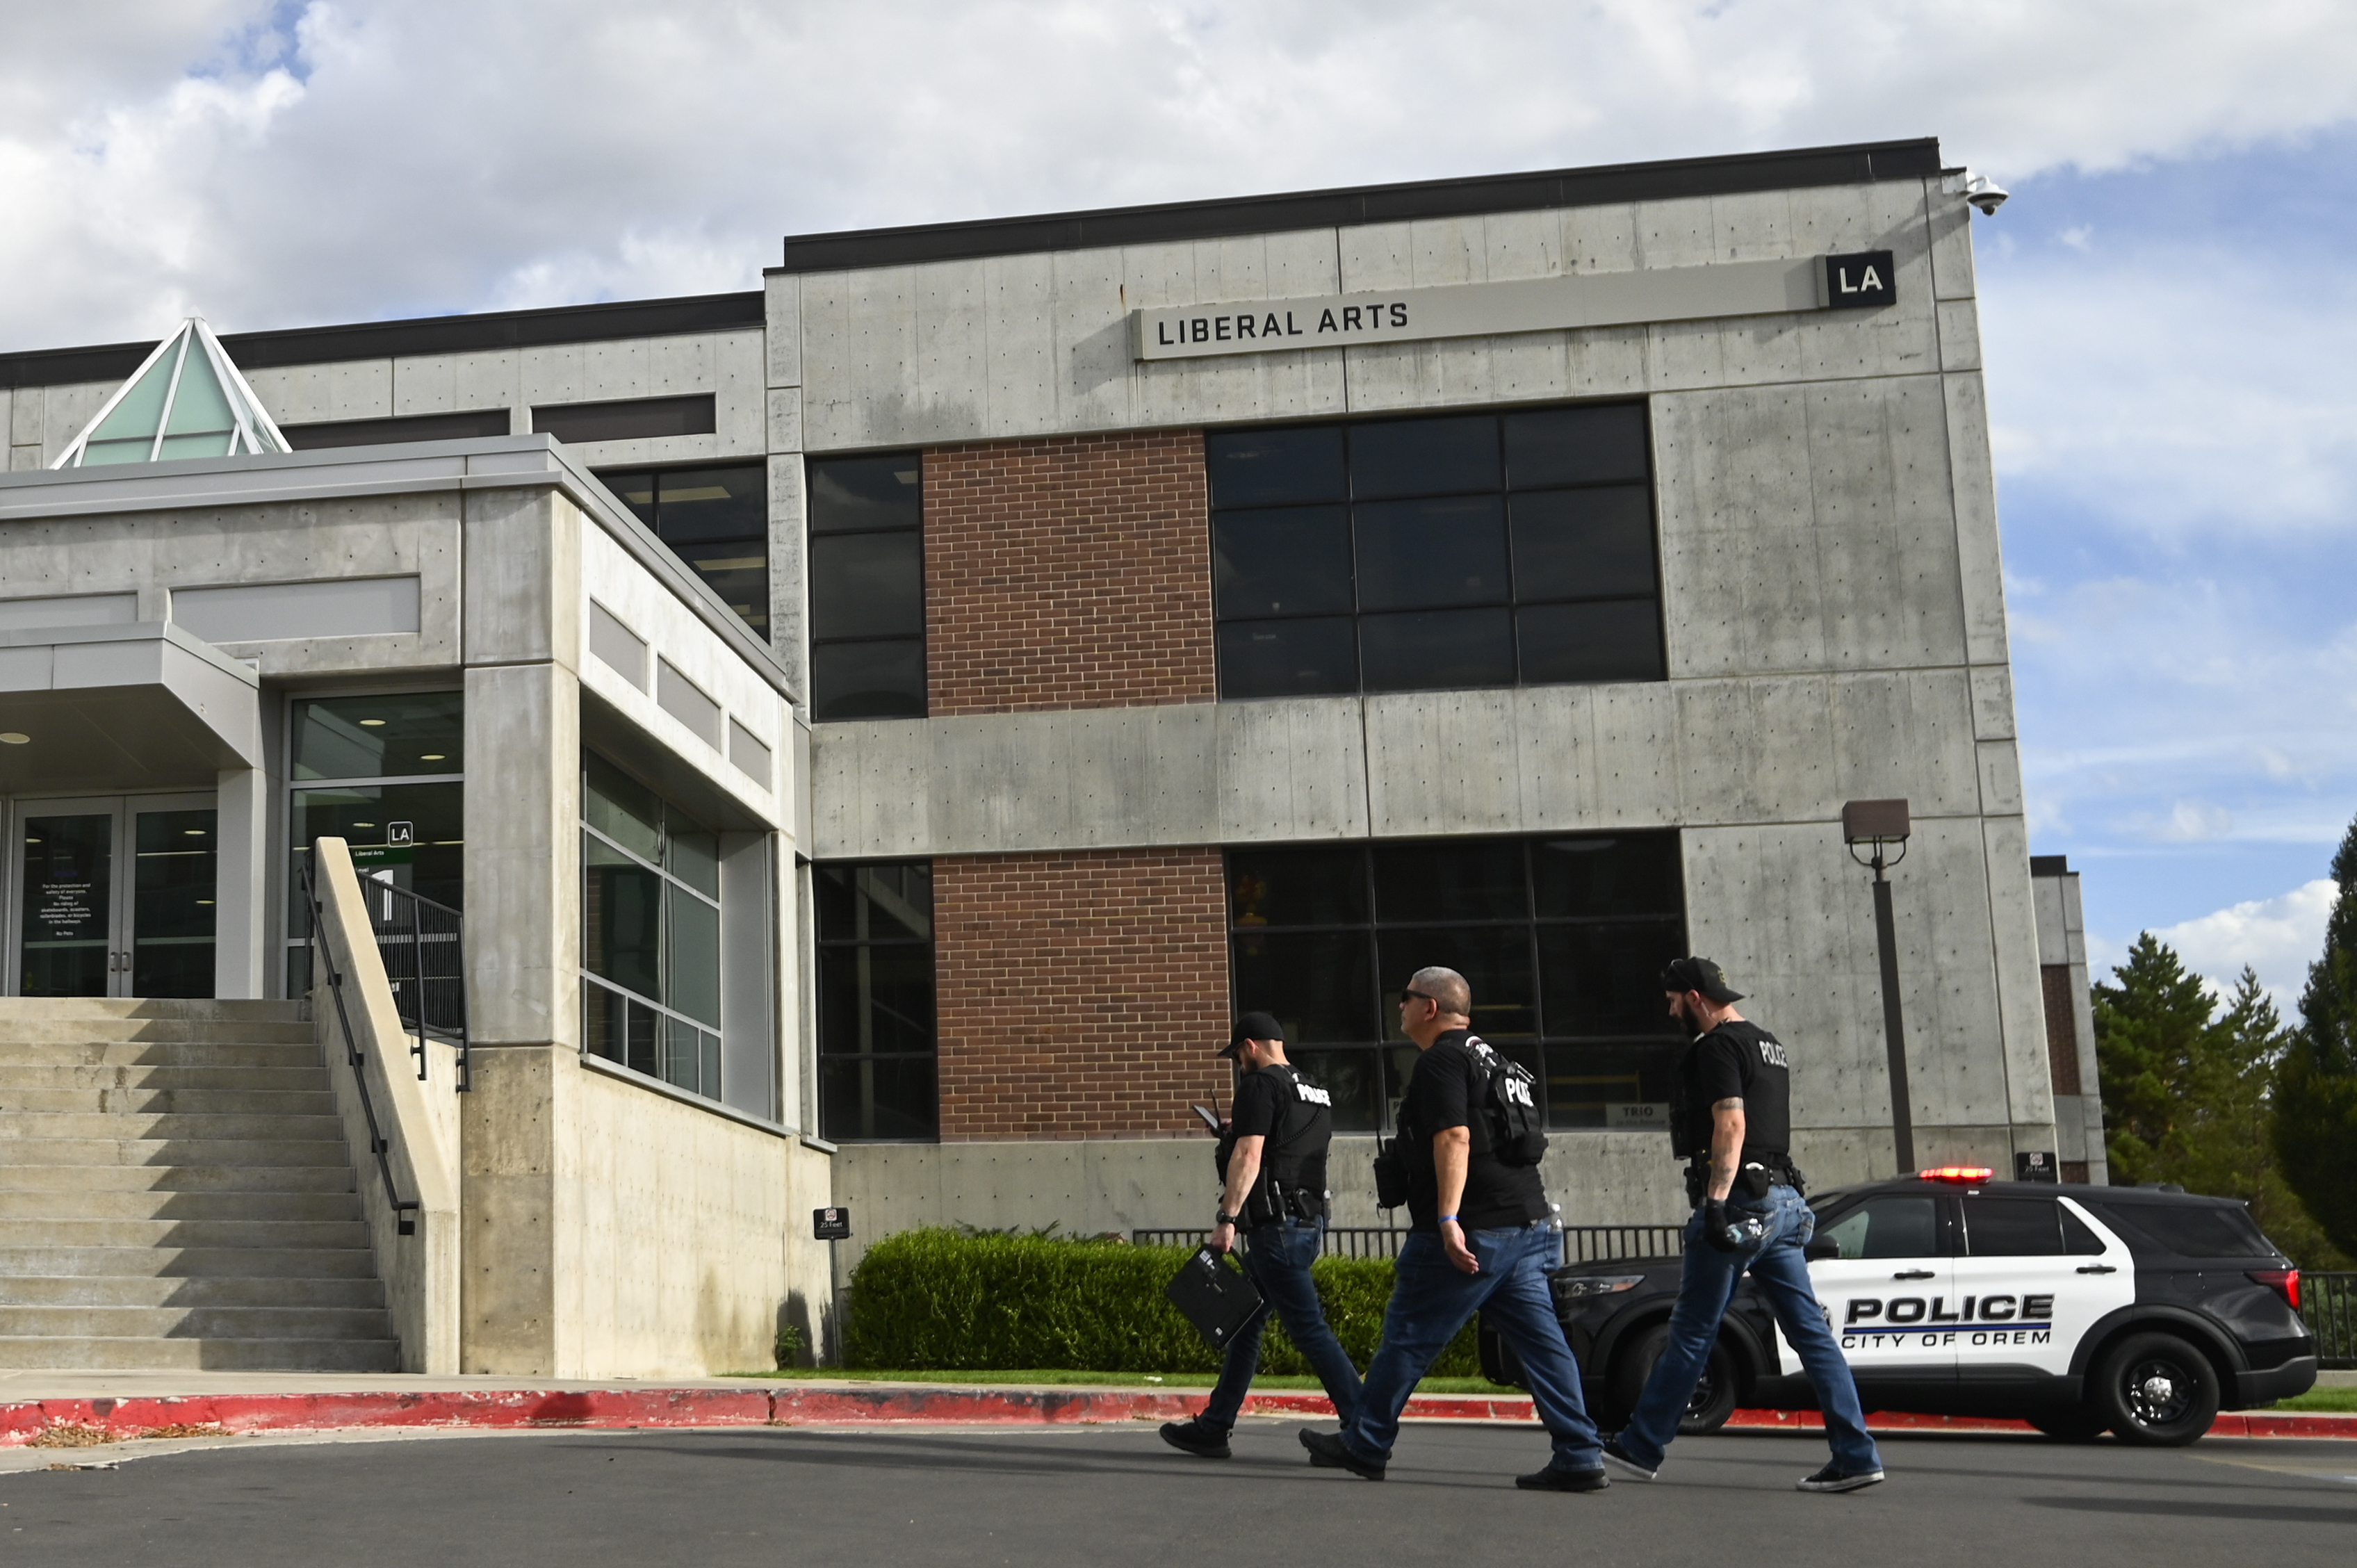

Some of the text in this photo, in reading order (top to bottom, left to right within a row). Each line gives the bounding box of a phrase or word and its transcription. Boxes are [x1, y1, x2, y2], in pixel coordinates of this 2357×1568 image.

[1839, 265, 1883, 293] LA
[1159, 302, 1408, 345] LIBERAL ARTS
[392, 828, 409, 841] LA
[1622, 1106, 1654, 1116] TRIO
[1844, 1293, 2055, 1325] POLICE
[1842, 1331, 2050, 1348] CITY OF OREM
